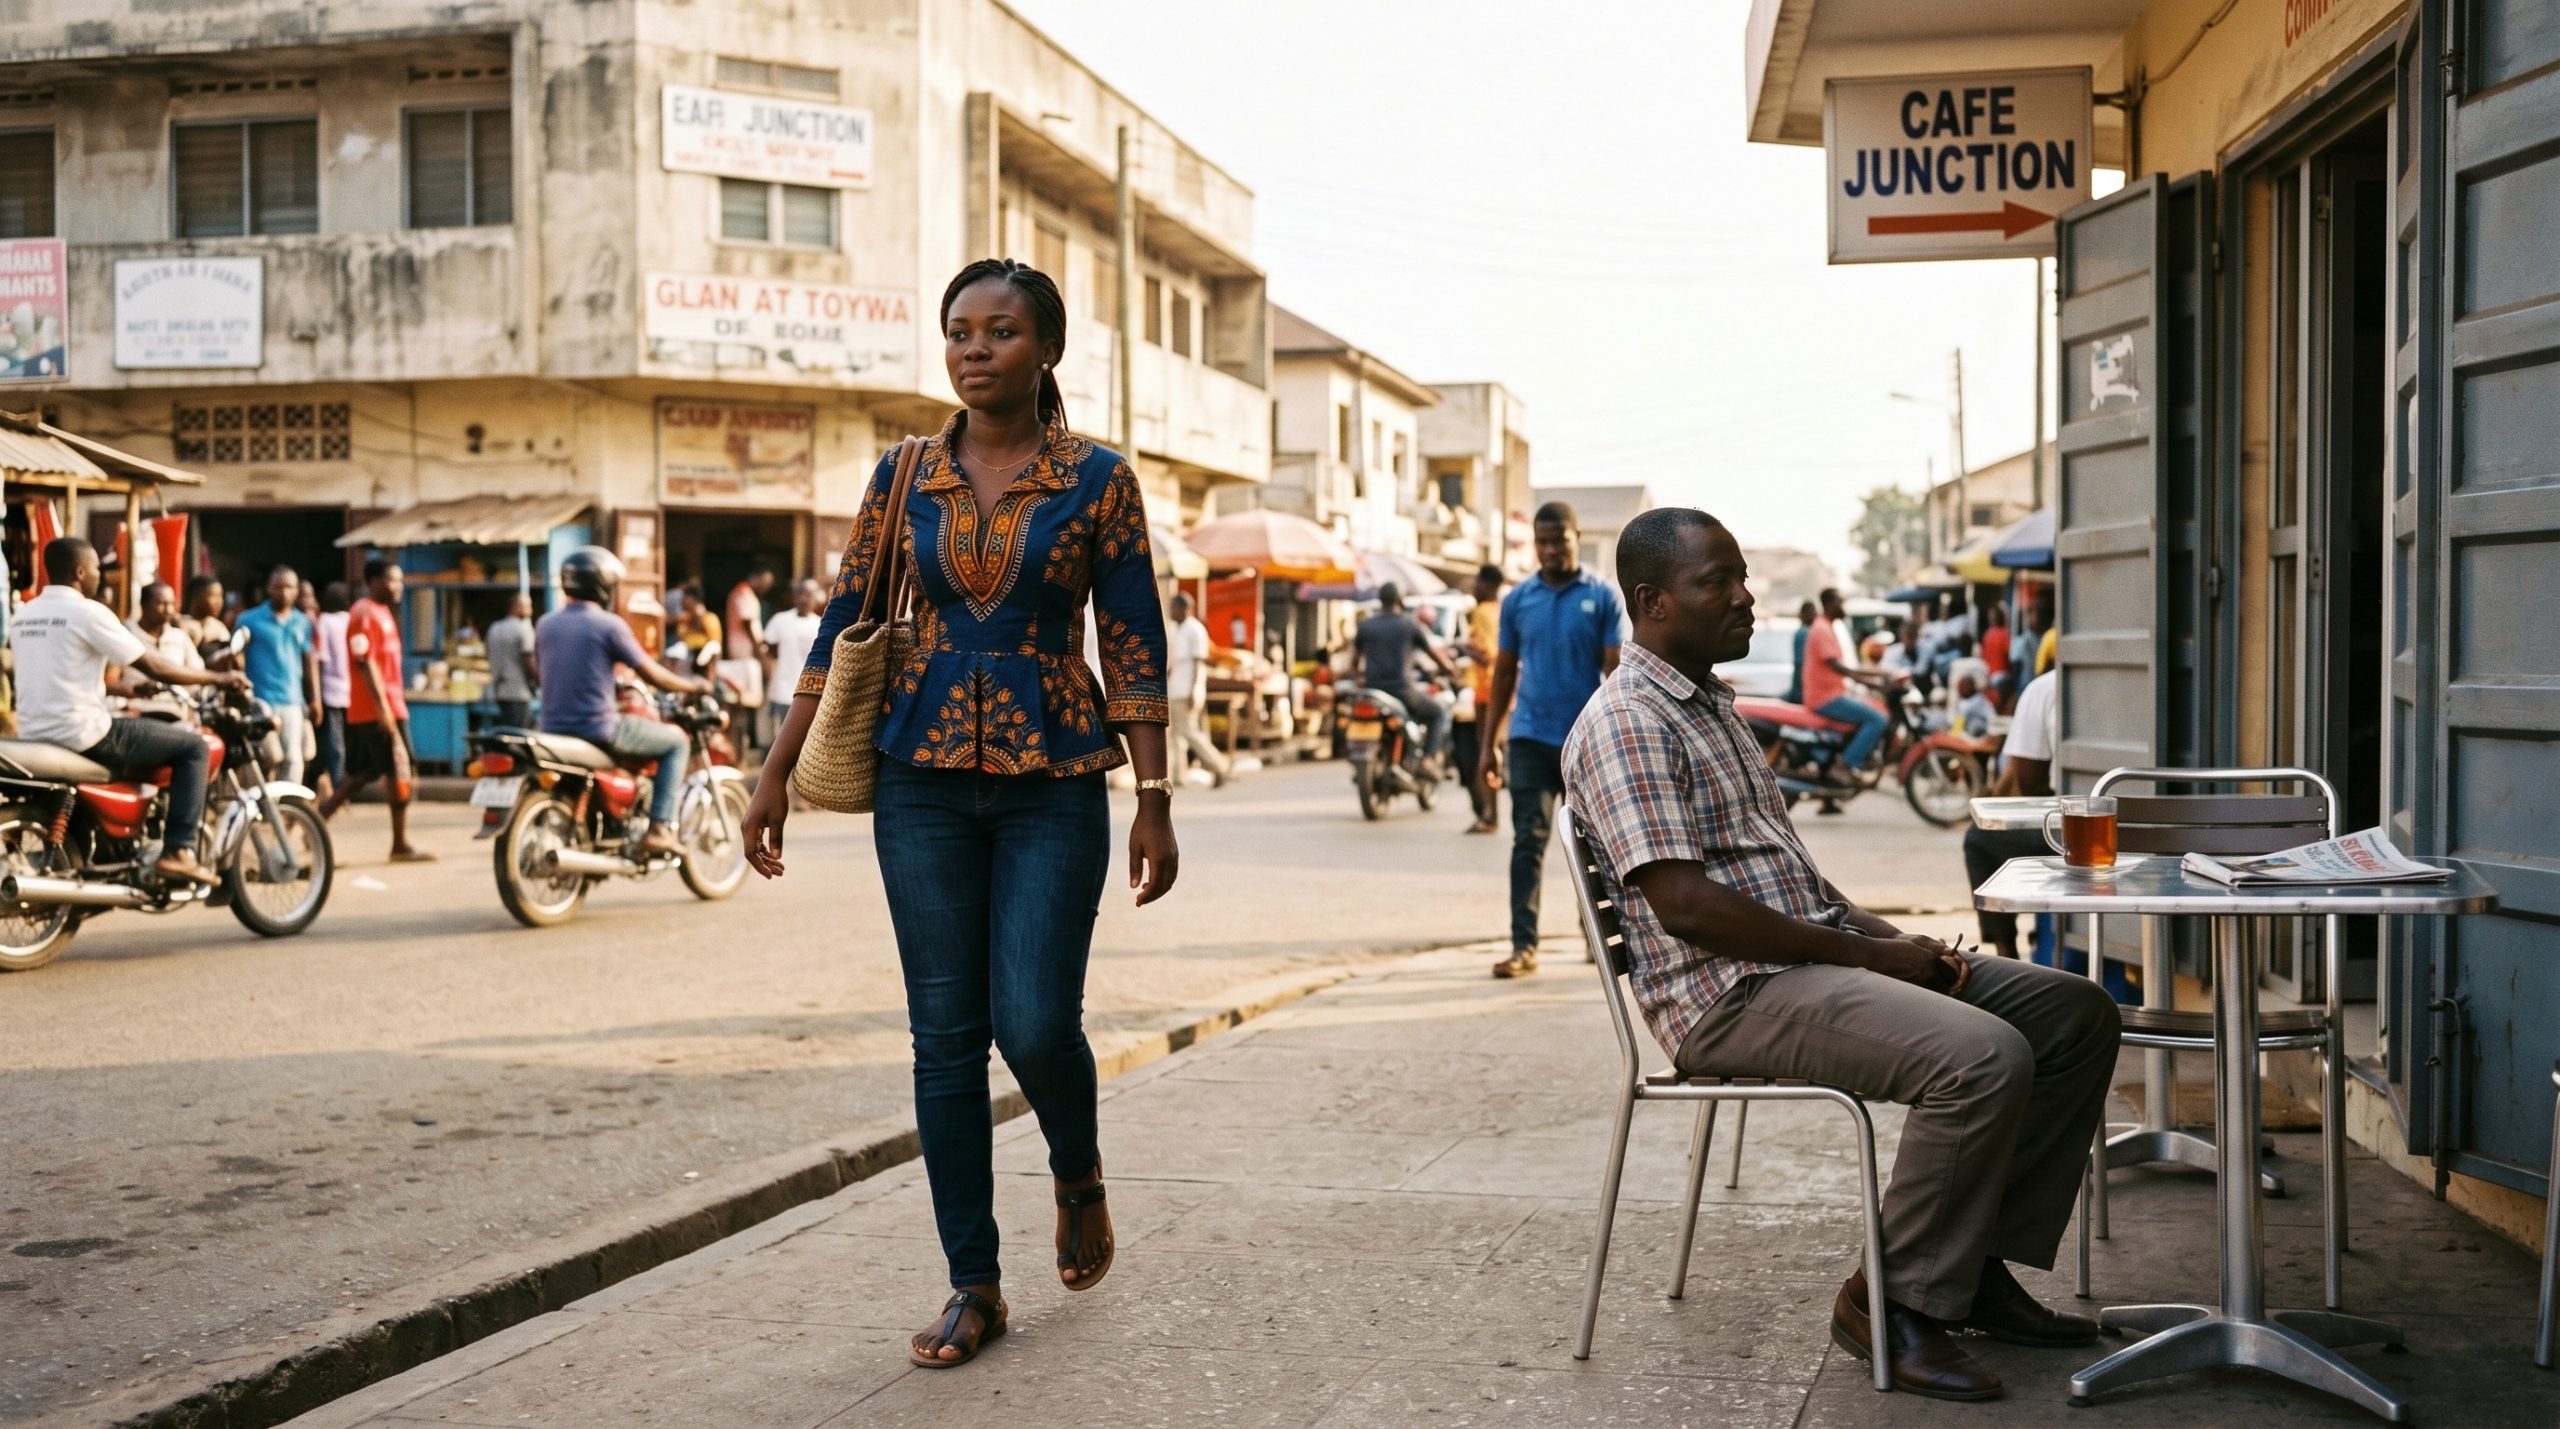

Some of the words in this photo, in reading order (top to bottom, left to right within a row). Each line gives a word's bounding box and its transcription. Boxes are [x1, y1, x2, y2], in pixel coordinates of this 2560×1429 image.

[743, 104, 866, 144] JUNCTION
[1901, 86, 2016, 139] CAFE
[1844, 140, 2075, 197] JUNCTION
[656, 279, 740, 311] GLAN
[755, 287, 792, 314] AT
[805, 290, 910, 326] TOYWA
